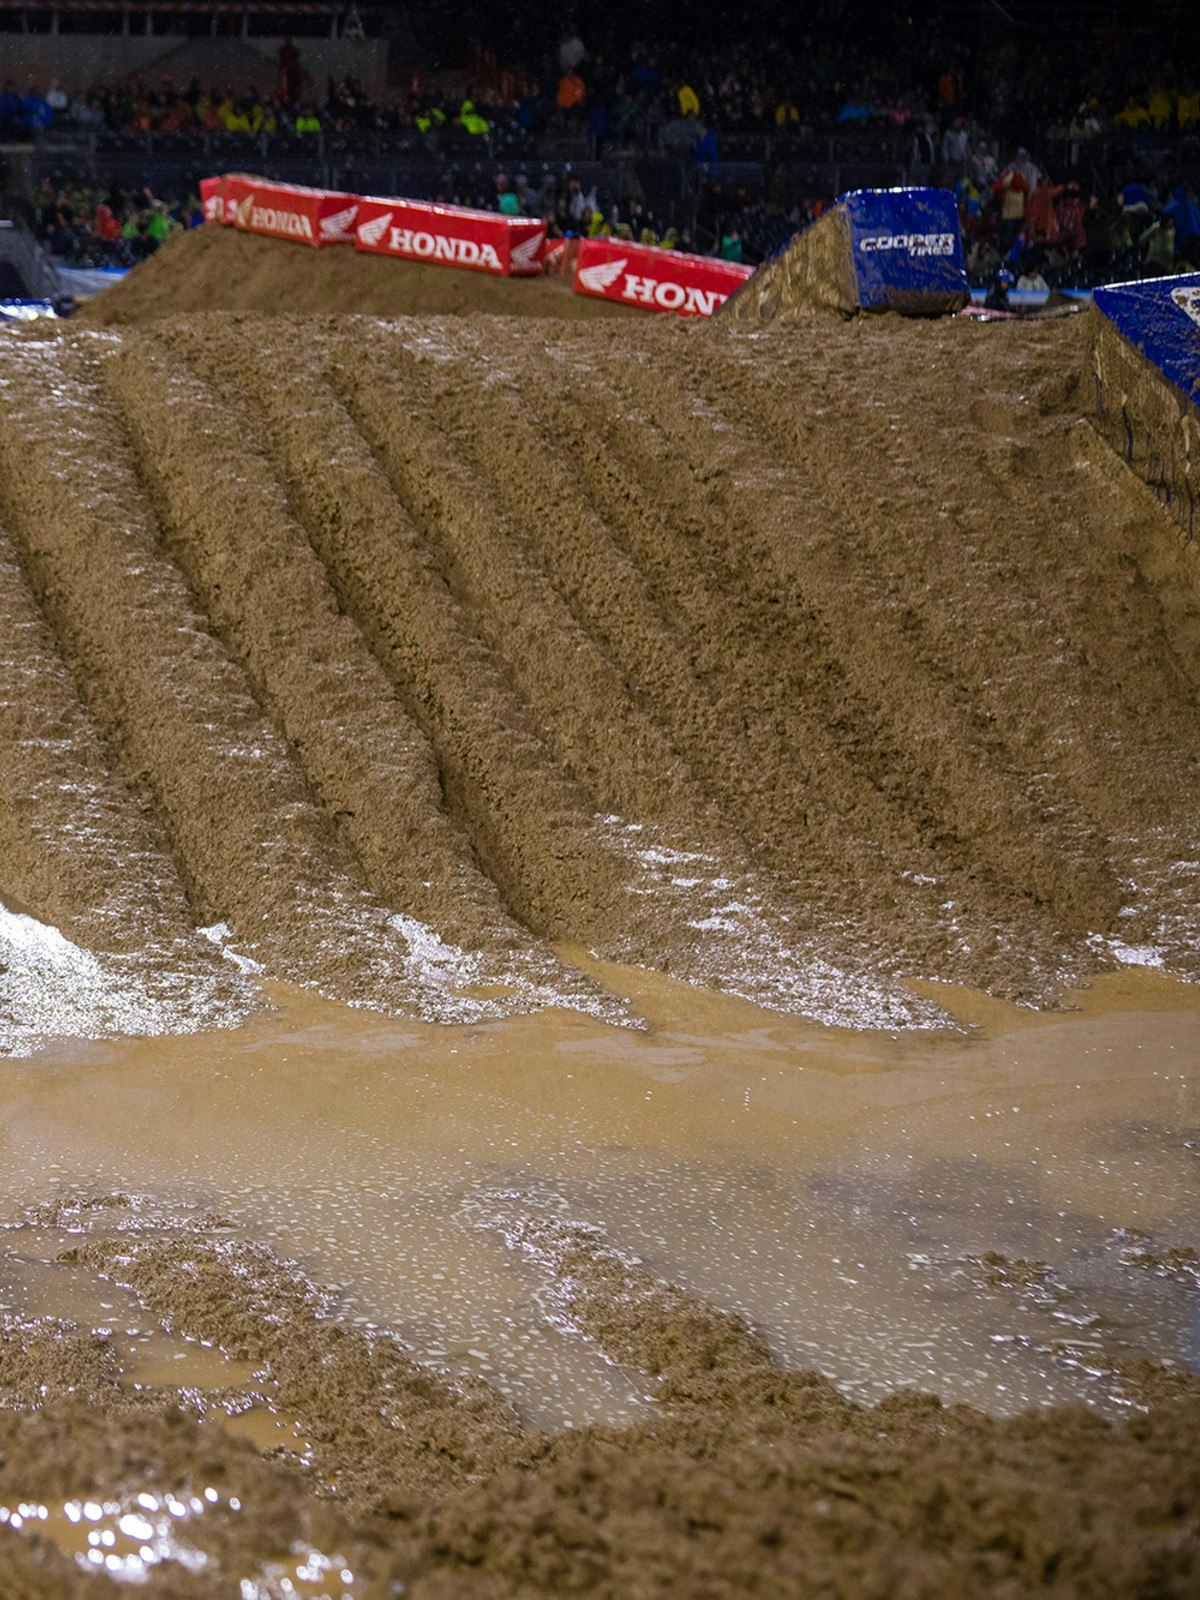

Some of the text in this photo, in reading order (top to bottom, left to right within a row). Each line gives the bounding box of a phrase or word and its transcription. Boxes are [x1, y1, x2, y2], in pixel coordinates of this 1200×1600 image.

[252, 207, 313, 238] HONDA
[390, 227, 503, 268] HONDA
[860, 233, 955, 251] COOPER
[623, 274, 728, 316] HON
